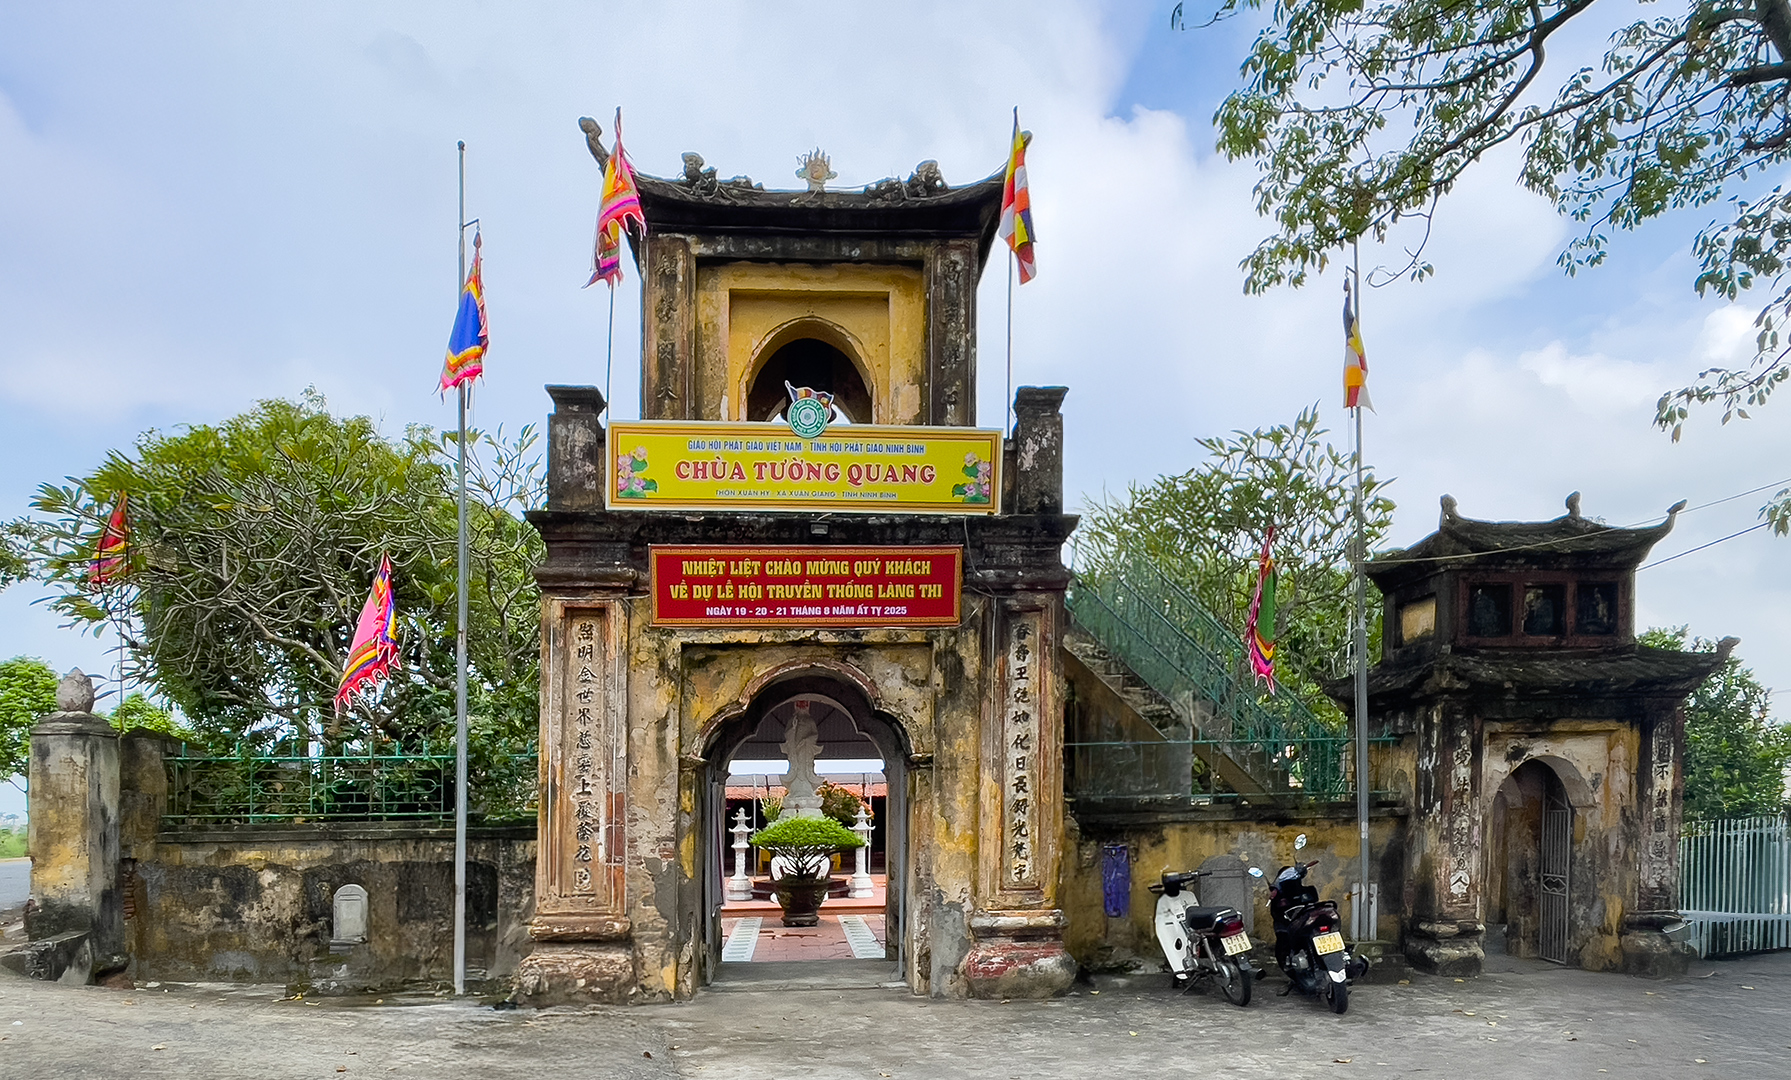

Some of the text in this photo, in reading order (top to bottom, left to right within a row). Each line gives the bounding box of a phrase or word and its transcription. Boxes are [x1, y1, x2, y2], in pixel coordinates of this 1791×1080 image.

[784, 442, 802, 451] NAM
[886, 444, 904, 453] NINH
[676, 456, 935, 486] CHÙA TƯỜNG QUANG
[682, 557, 931, 578] NHIỆT LIỆT CHÀO MỪNG QUÝ KHÁCH
[669, 579, 942, 602] VỀ DỰ LỄ HỘI TRUYỀN THỐNG LÀNG THI
[706, 605, 732, 616] NGÀY
[734, 607, 747, 616] 19
[755, 607, 767, 616] 20
[776, 607, 787, 616] 21
[790, 605, 821, 615] THÁNG
[823, 606, 830, 615] 8
[832, 605, 855, 615] NĂM
[857, 603, 869, 615] ẤT
[870, 606, 882, 617] TỴ
[884, 606, 907, 615] 2025
